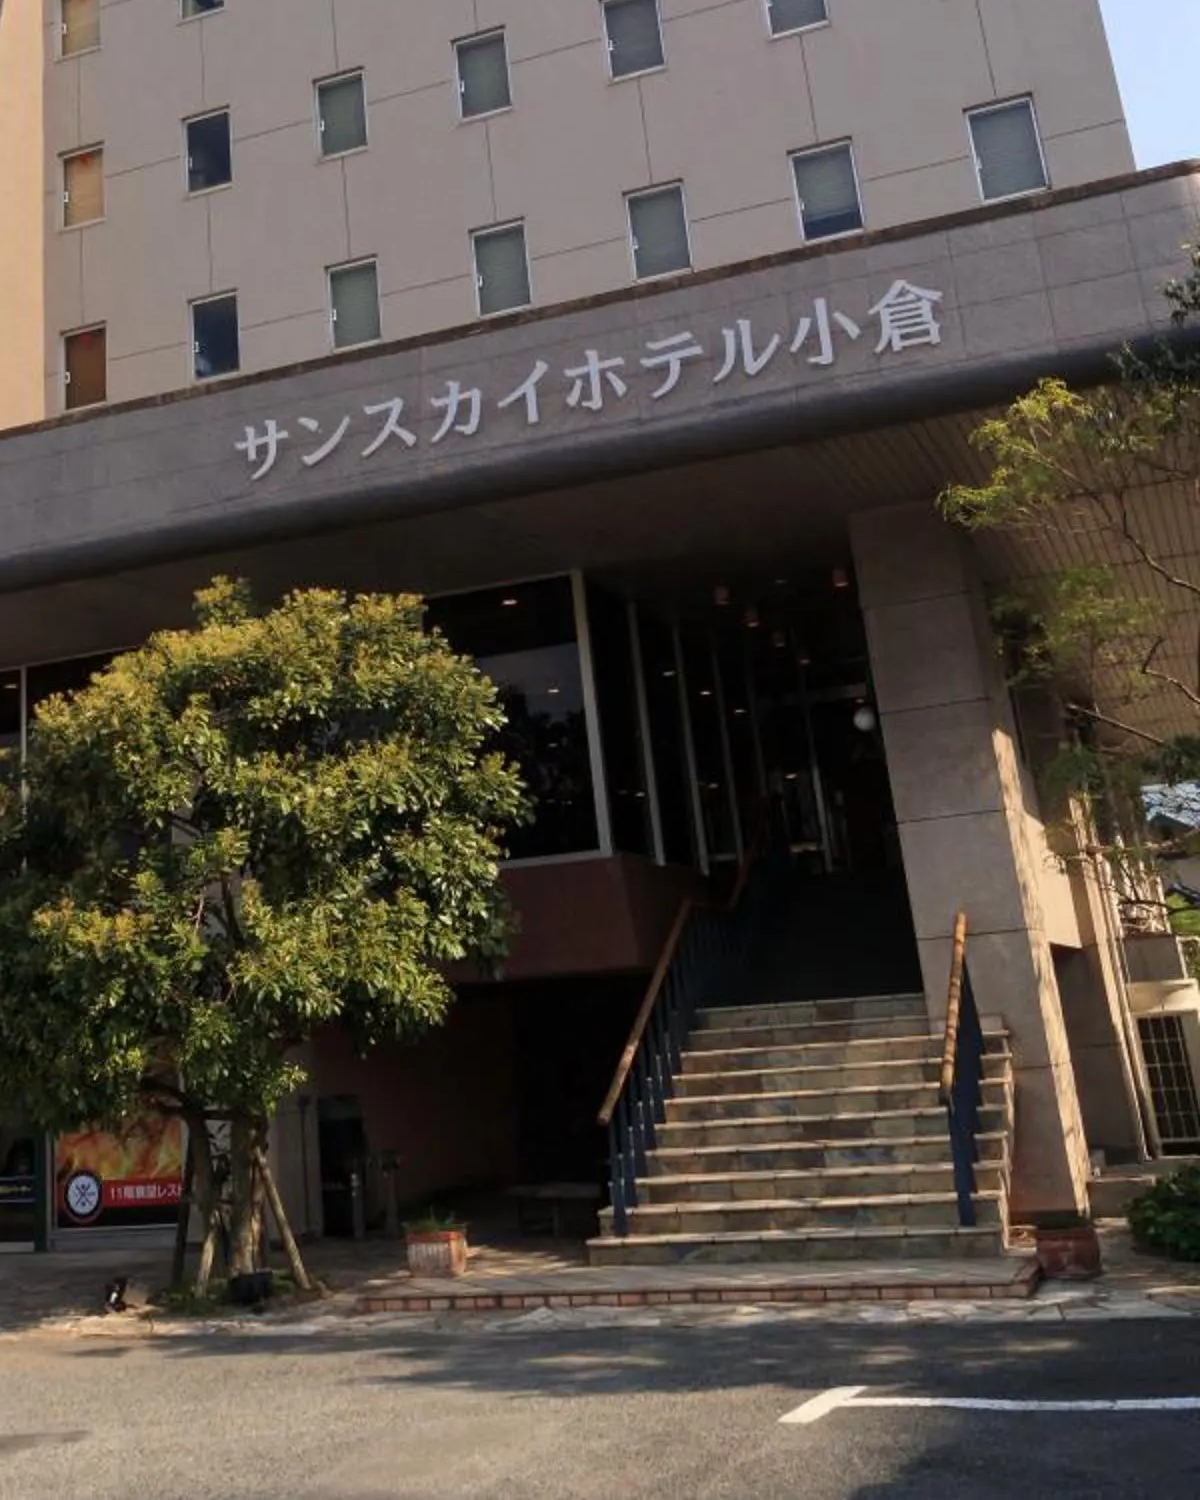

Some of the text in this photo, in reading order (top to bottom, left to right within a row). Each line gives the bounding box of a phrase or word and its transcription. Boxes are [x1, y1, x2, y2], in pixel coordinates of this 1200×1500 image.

[234, 279, 944, 480] サンスカイホテル小倉
